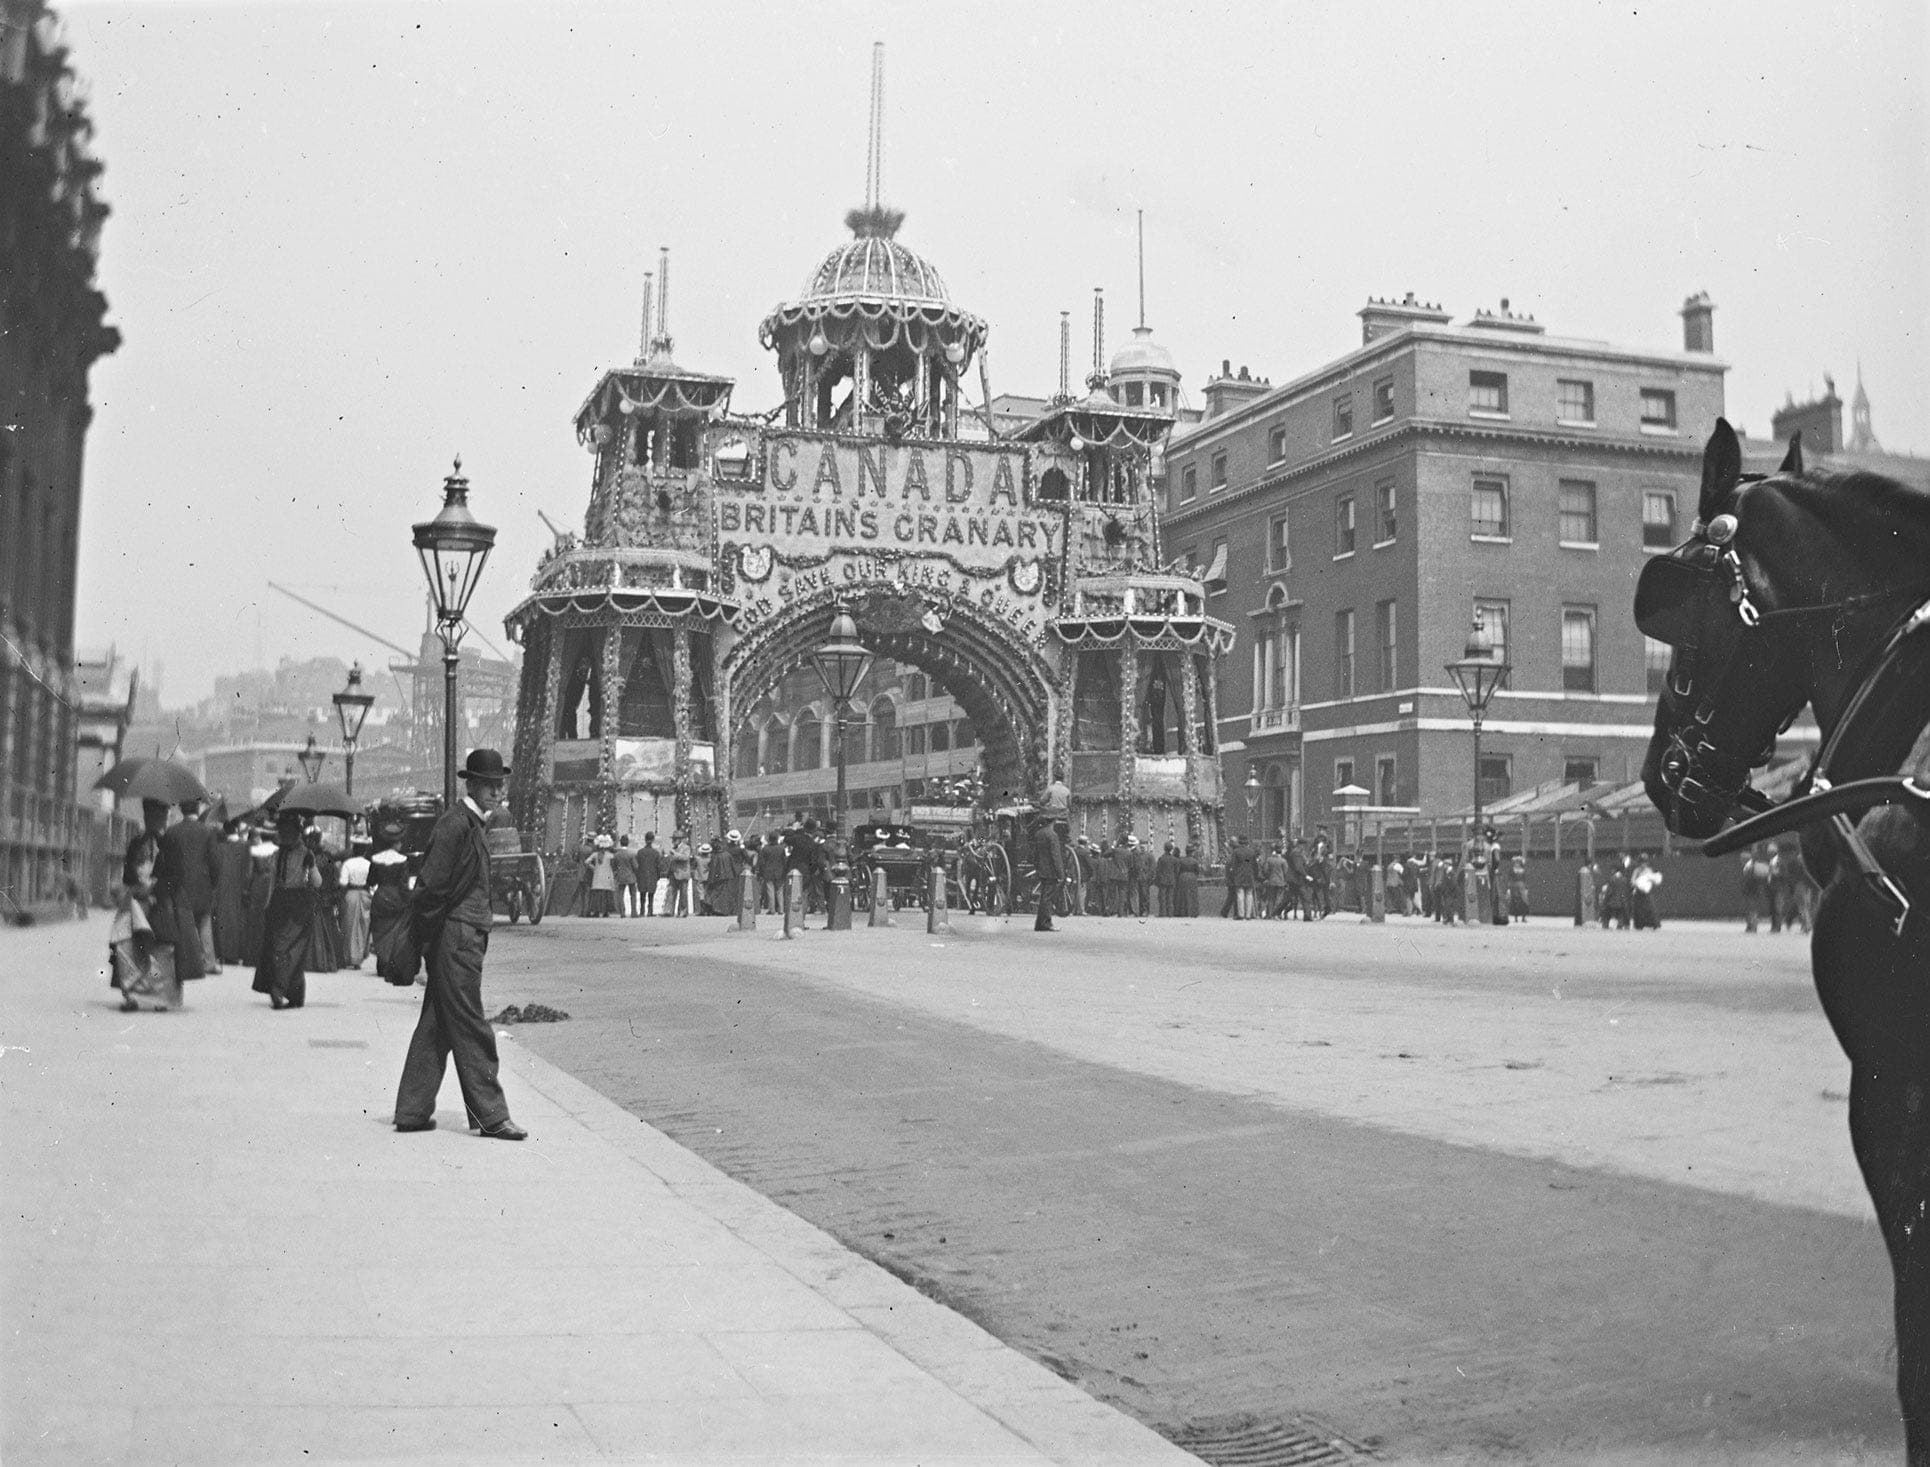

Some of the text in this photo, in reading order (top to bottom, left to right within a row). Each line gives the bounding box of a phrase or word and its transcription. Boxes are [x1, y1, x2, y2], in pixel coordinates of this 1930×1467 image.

[769, 438, 1017, 506] CANADA
[893, 513, 1061, 552] GRANARY
[732, 597, 773, 635] GOD
[777, 566, 835, 600] SAVE
[843, 558, 888, 581] OUR
[898, 560, 951, 587] KING
[981, 588, 1050, 651] QUEEN
